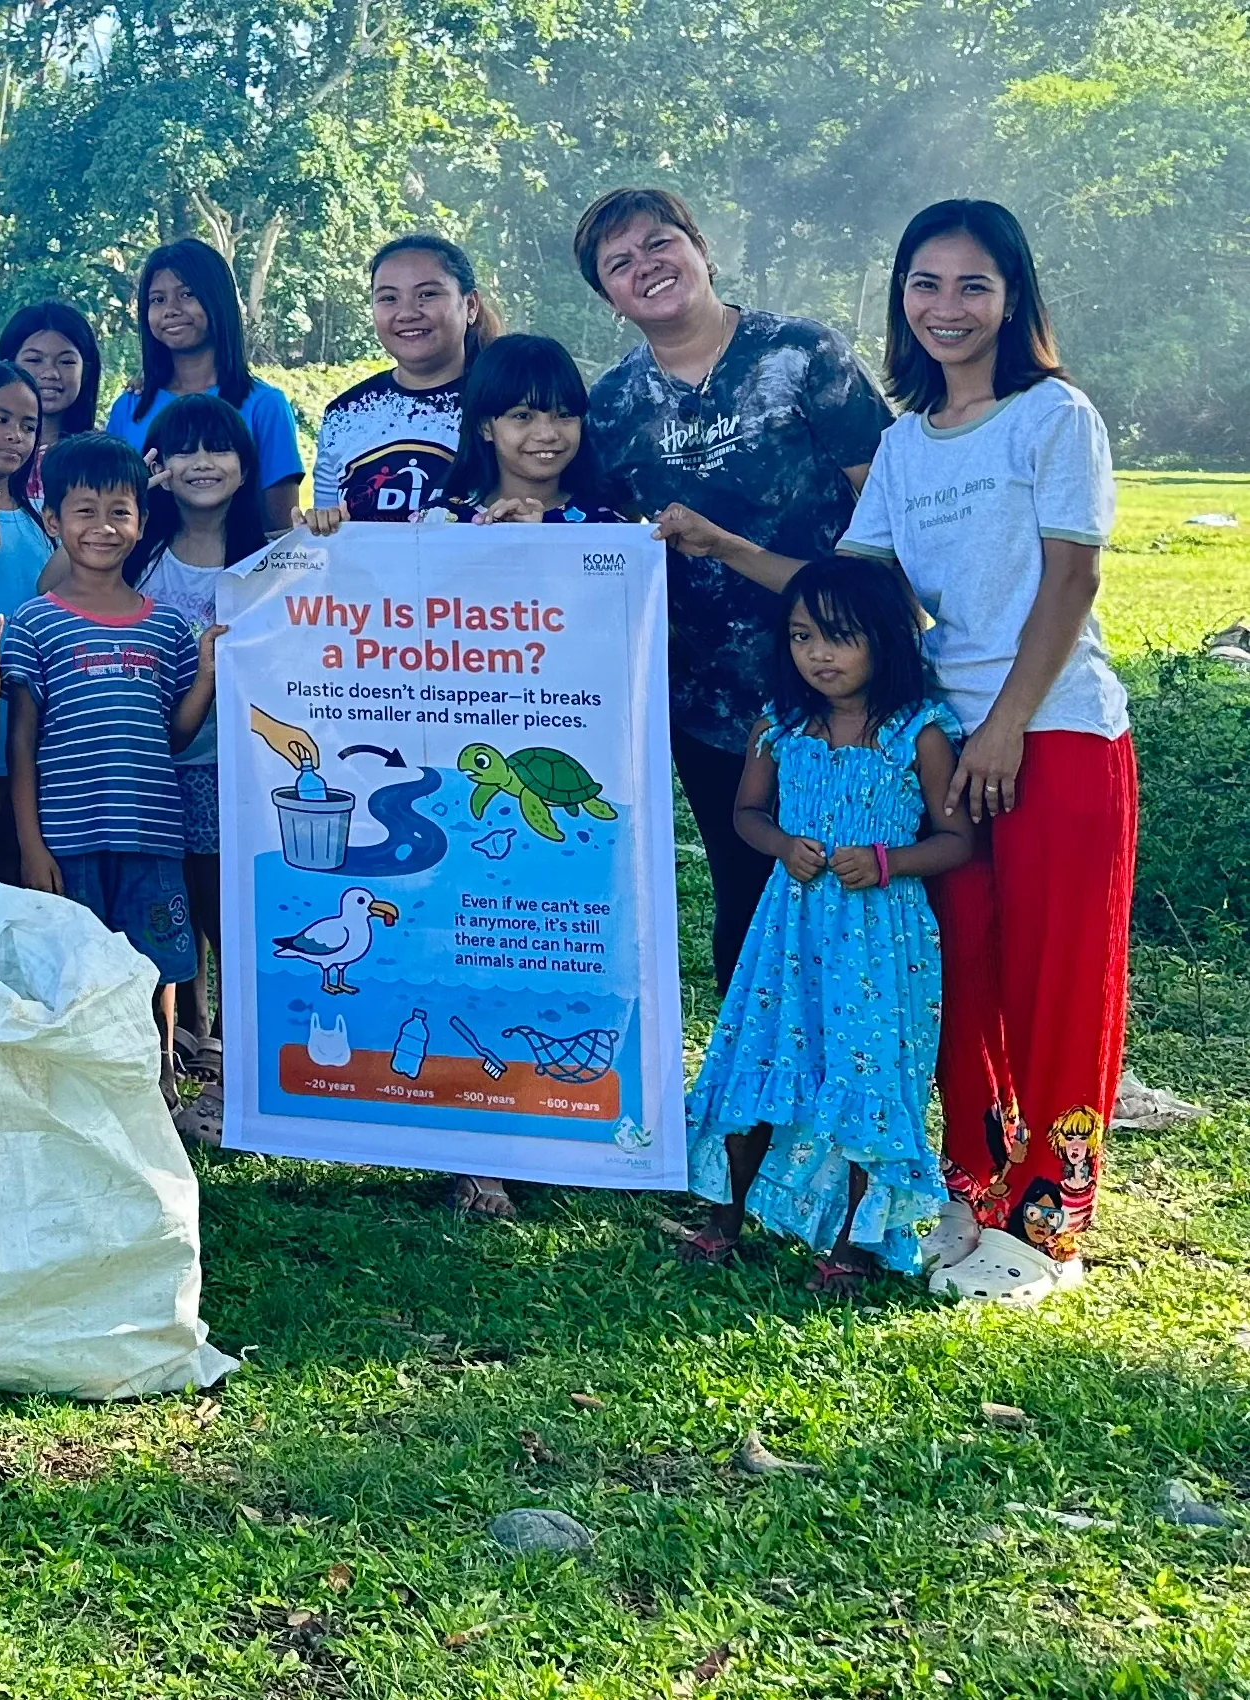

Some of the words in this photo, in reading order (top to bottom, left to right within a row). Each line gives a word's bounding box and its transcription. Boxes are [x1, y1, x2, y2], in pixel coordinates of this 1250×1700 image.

[270, 551, 308, 560] OCEAN
[583, 553, 626, 564] KOMA
[285, 596, 371, 635] Why
[383, 598, 415, 629] Is
[426, 598, 565, 632] Plastic
[322, 645, 343, 669] a
[355, 639, 546, 674] Problem?
[287, 681, 344, 698] Plastic
[349, 683, 416, 701] doesn’t
[541, 689, 602, 707] breaks
[309, 702, 343, 720] into
[347, 705, 412, 722] smaller
[416, 708, 449, 724] and
[453, 709, 519, 727] smaller
[524, 711, 588, 731] pieces.
[461, 893, 498, 909] Even
[502, 895, 513, 910] if
[515, 900, 538, 912] we
[541, 899, 580, 914] can’t
[583, 903, 610, 916] see
[455, 912, 466, 926] it
[469, 916, 541, 933] anymore,
[544, 917, 568, 932] it’s
[571, 919, 600, 934] still
[455, 932, 495, 947] there
[499, 935, 528, 949] and
[531, 939, 560, 951] can
[563, 938, 605, 954] harm
[455, 952, 515, 968] animals
[518, 956, 547, 971] and
[551, 958, 606, 974] nature.
[304, 1079, 326, 1090] ~20
[327, 1080, 356, 1094] years
[375, 1084, 405, 1096] ~450
[405, 1087, 435, 1099] years
[454, 1091, 485, 1102] ~500
[486, 1093, 516, 1106] years
[569, 1100, 600, 1113] years
